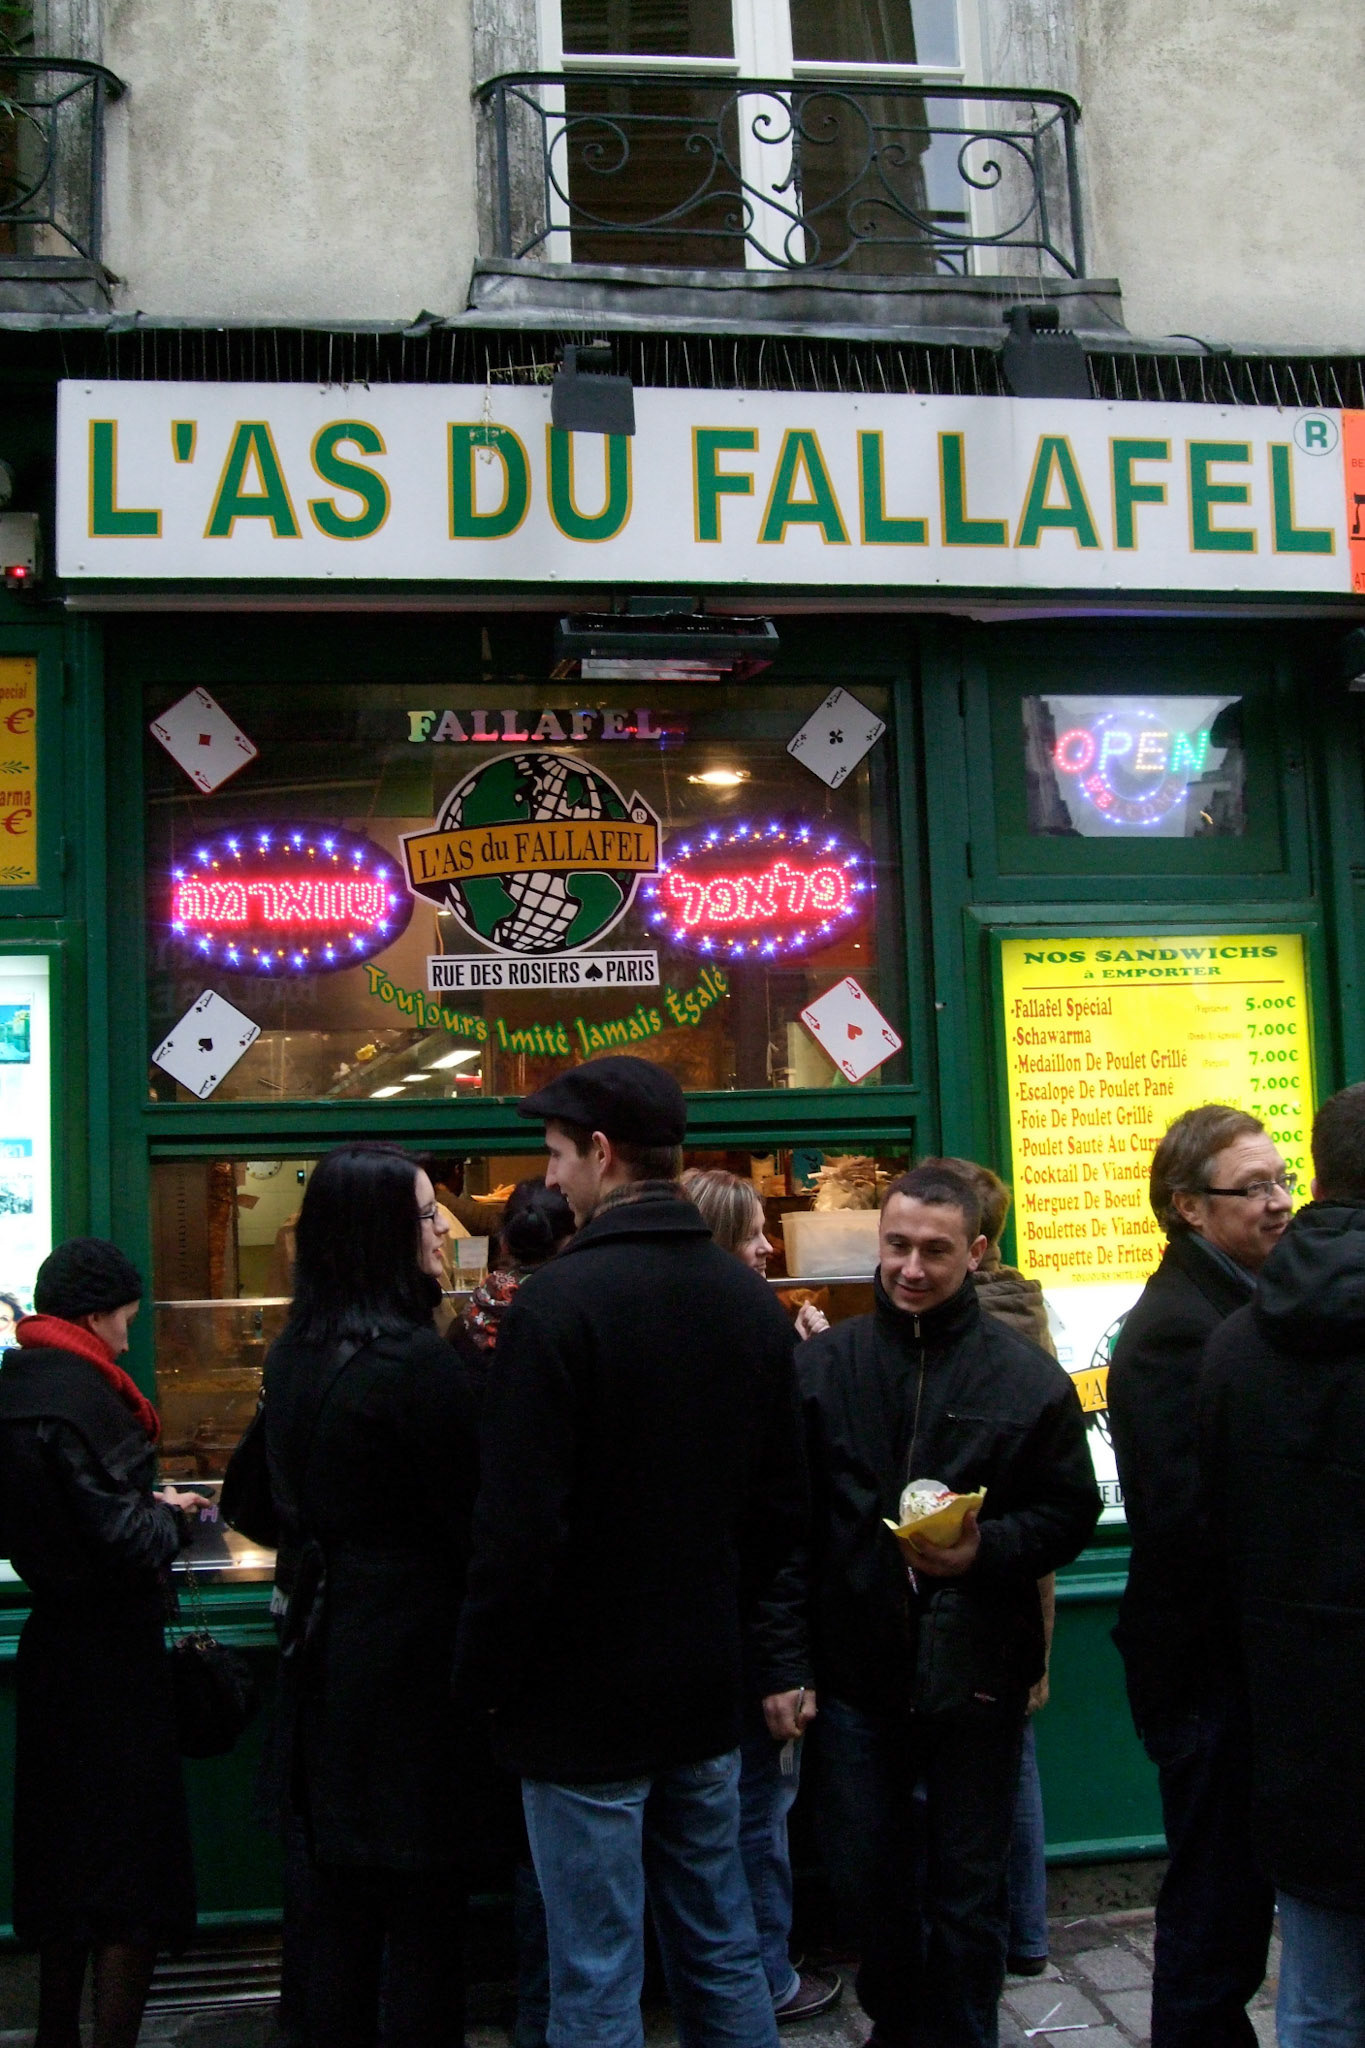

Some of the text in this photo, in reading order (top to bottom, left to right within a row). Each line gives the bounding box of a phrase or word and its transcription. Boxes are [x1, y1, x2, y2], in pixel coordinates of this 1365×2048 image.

[88, 418, 392, 541] L'AS
[447, 421, 634, 544] DU
[691, 425, 1337, 557] FALLAFEL
[407, 709, 662, 743] FALLAFEL
[1055, 730, 1210, 773] OPEN
[418, 831, 650, 880] L'AS du FALLAFEL
[179, 881, 386, 924] שווארמה
[669, 862, 846, 925] פלאפל
[1024, 946, 1278, 964] NOS SANDWICHS
[432, 959, 655, 987] RUE DES ROSIERS PARIS
[1102, 966, 1221, 978] EMPORTER
[364, 964, 488, 1043] Toujours
[575, 1004, 662, 1056] Jamais
[1014, 997, 1112, 1021] Fallafel Spécial
[1016, 1026, 1091, 1046] Schawarma
[1018, 1053, 1081, 1073] Medaillon
[1086, 1052, 1101, 1071] De
[1106, 1051, 1147, 1070] Poulet
[1150, 1048, 1188, 1069] Grillé
[1019, 1076, 1174, 1104] Escalope De Poulet Pané
[1021, 1106, 1153, 1129] Foie De Poulet Grillé
[1023, 1137, 1063, 1157] Poulet
[1067, 1135, 1104, 1155] Sauté
[1108, 1134, 1126, 1153] Au
[1024, 1163, 1078, 1184] Cocktail
[1082, 1163, 1098, 1182] De
[1025, 1189, 1141, 1216] Merguez De Boeuf
[1027, 1221, 1087, 1241] Boulettes
[1091, 1218, 1107, 1237] De
[1028, 1249, 1092, 1272] Barquette
[1097, 1246, 1113, 1265] De
[1117, 1244, 1153, 1264] Frites
